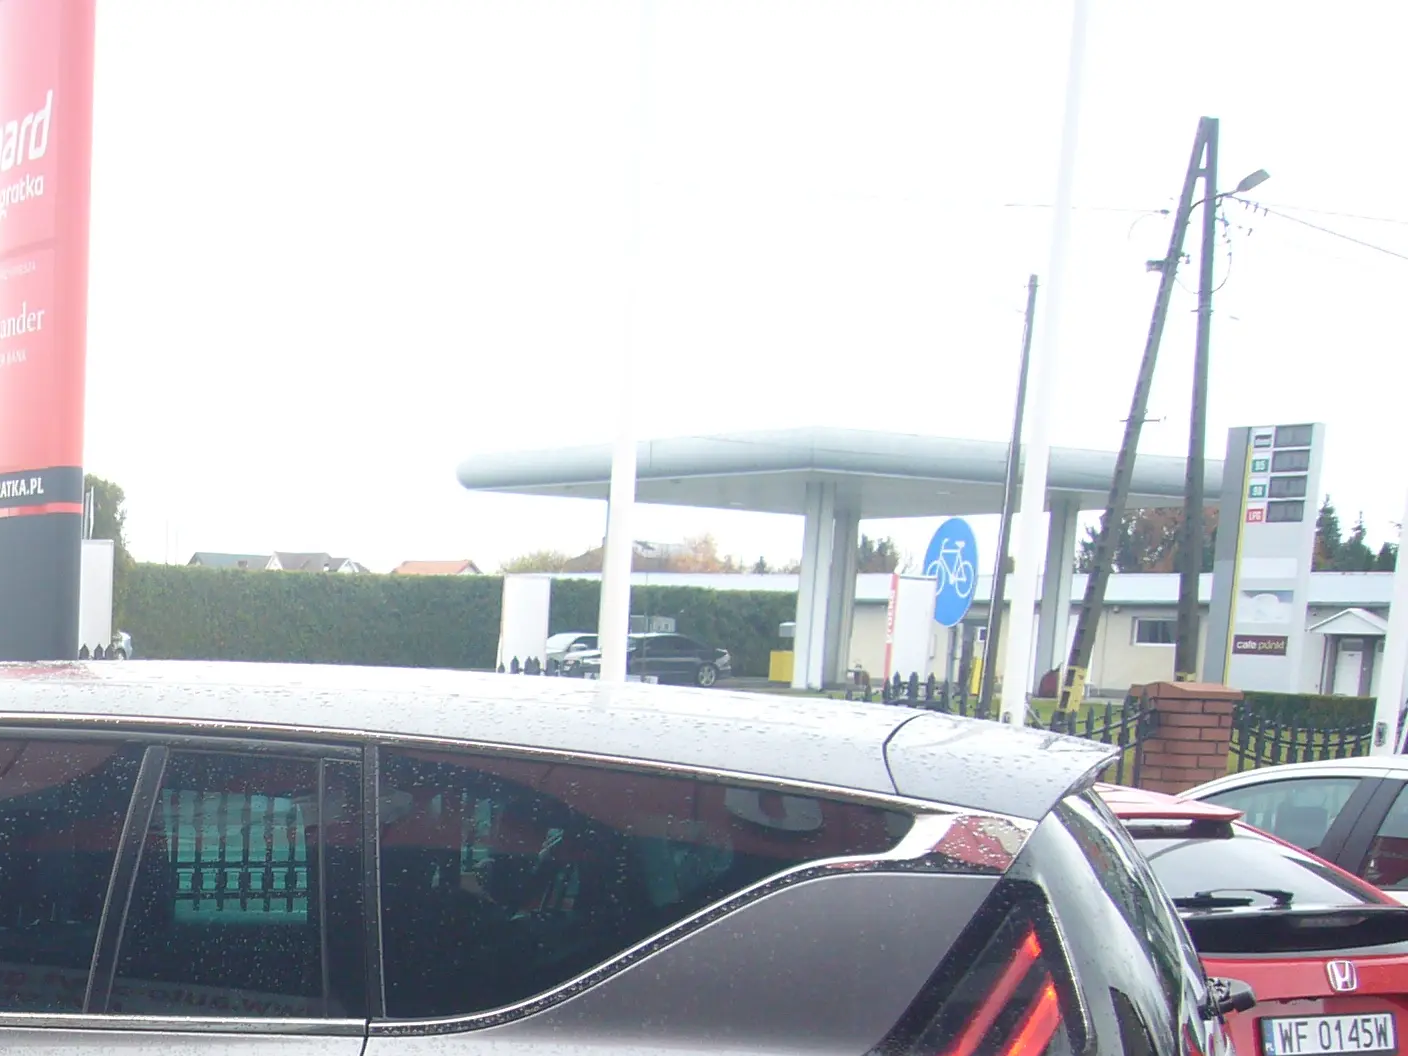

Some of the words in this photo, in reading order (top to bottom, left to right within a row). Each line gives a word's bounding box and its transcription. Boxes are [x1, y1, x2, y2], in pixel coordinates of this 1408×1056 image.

[1248, 510, 1262, 521] LPG
[1278, 1020, 1308, 1053] WF
[1319, 1018, 1388, 1050] 0145W
